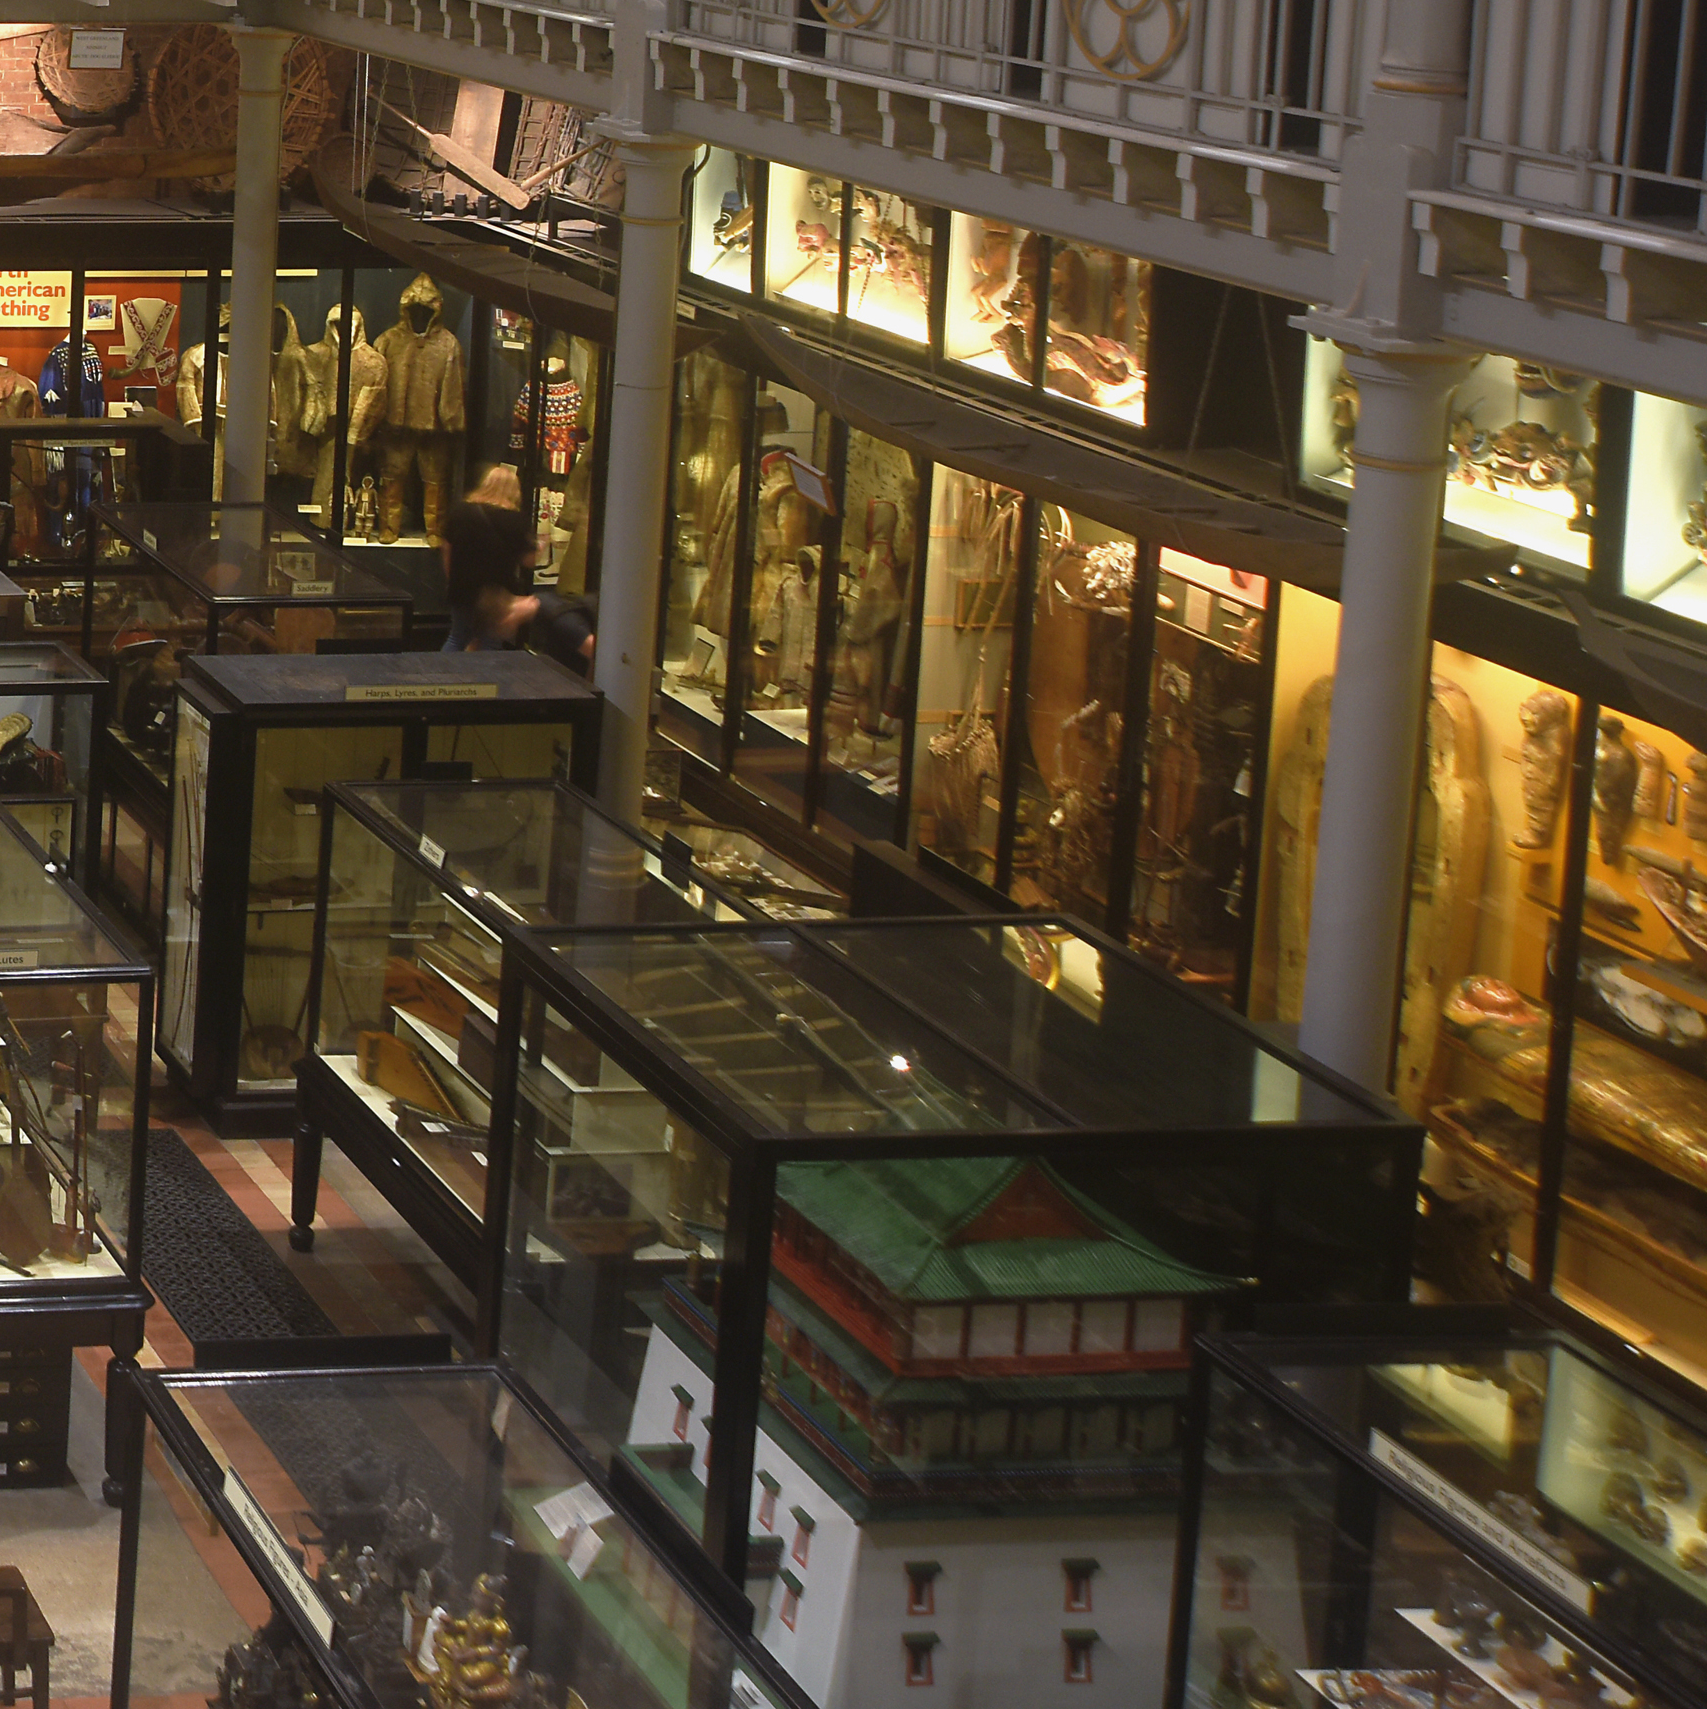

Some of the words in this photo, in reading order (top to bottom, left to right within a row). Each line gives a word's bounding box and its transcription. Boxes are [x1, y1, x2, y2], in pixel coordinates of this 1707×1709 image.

[296, 584, 329, 593] Saddlery
[365, 689, 391, 699] Harps,
[438, 688, 477, 696] Pluriarchs
[1388, 1449, 1435, 1495] Religious
[1437, 1485, 1478, 1525] Figures
[1481, 1520, 1504, 1544] and
[1508, 1540, 1566, 1590] Artefacts
[243, 1502, 269, 1549] Religious
[268, 1539, 290, 1579] Figures
[294, 1580, 308, 1608] Asia
